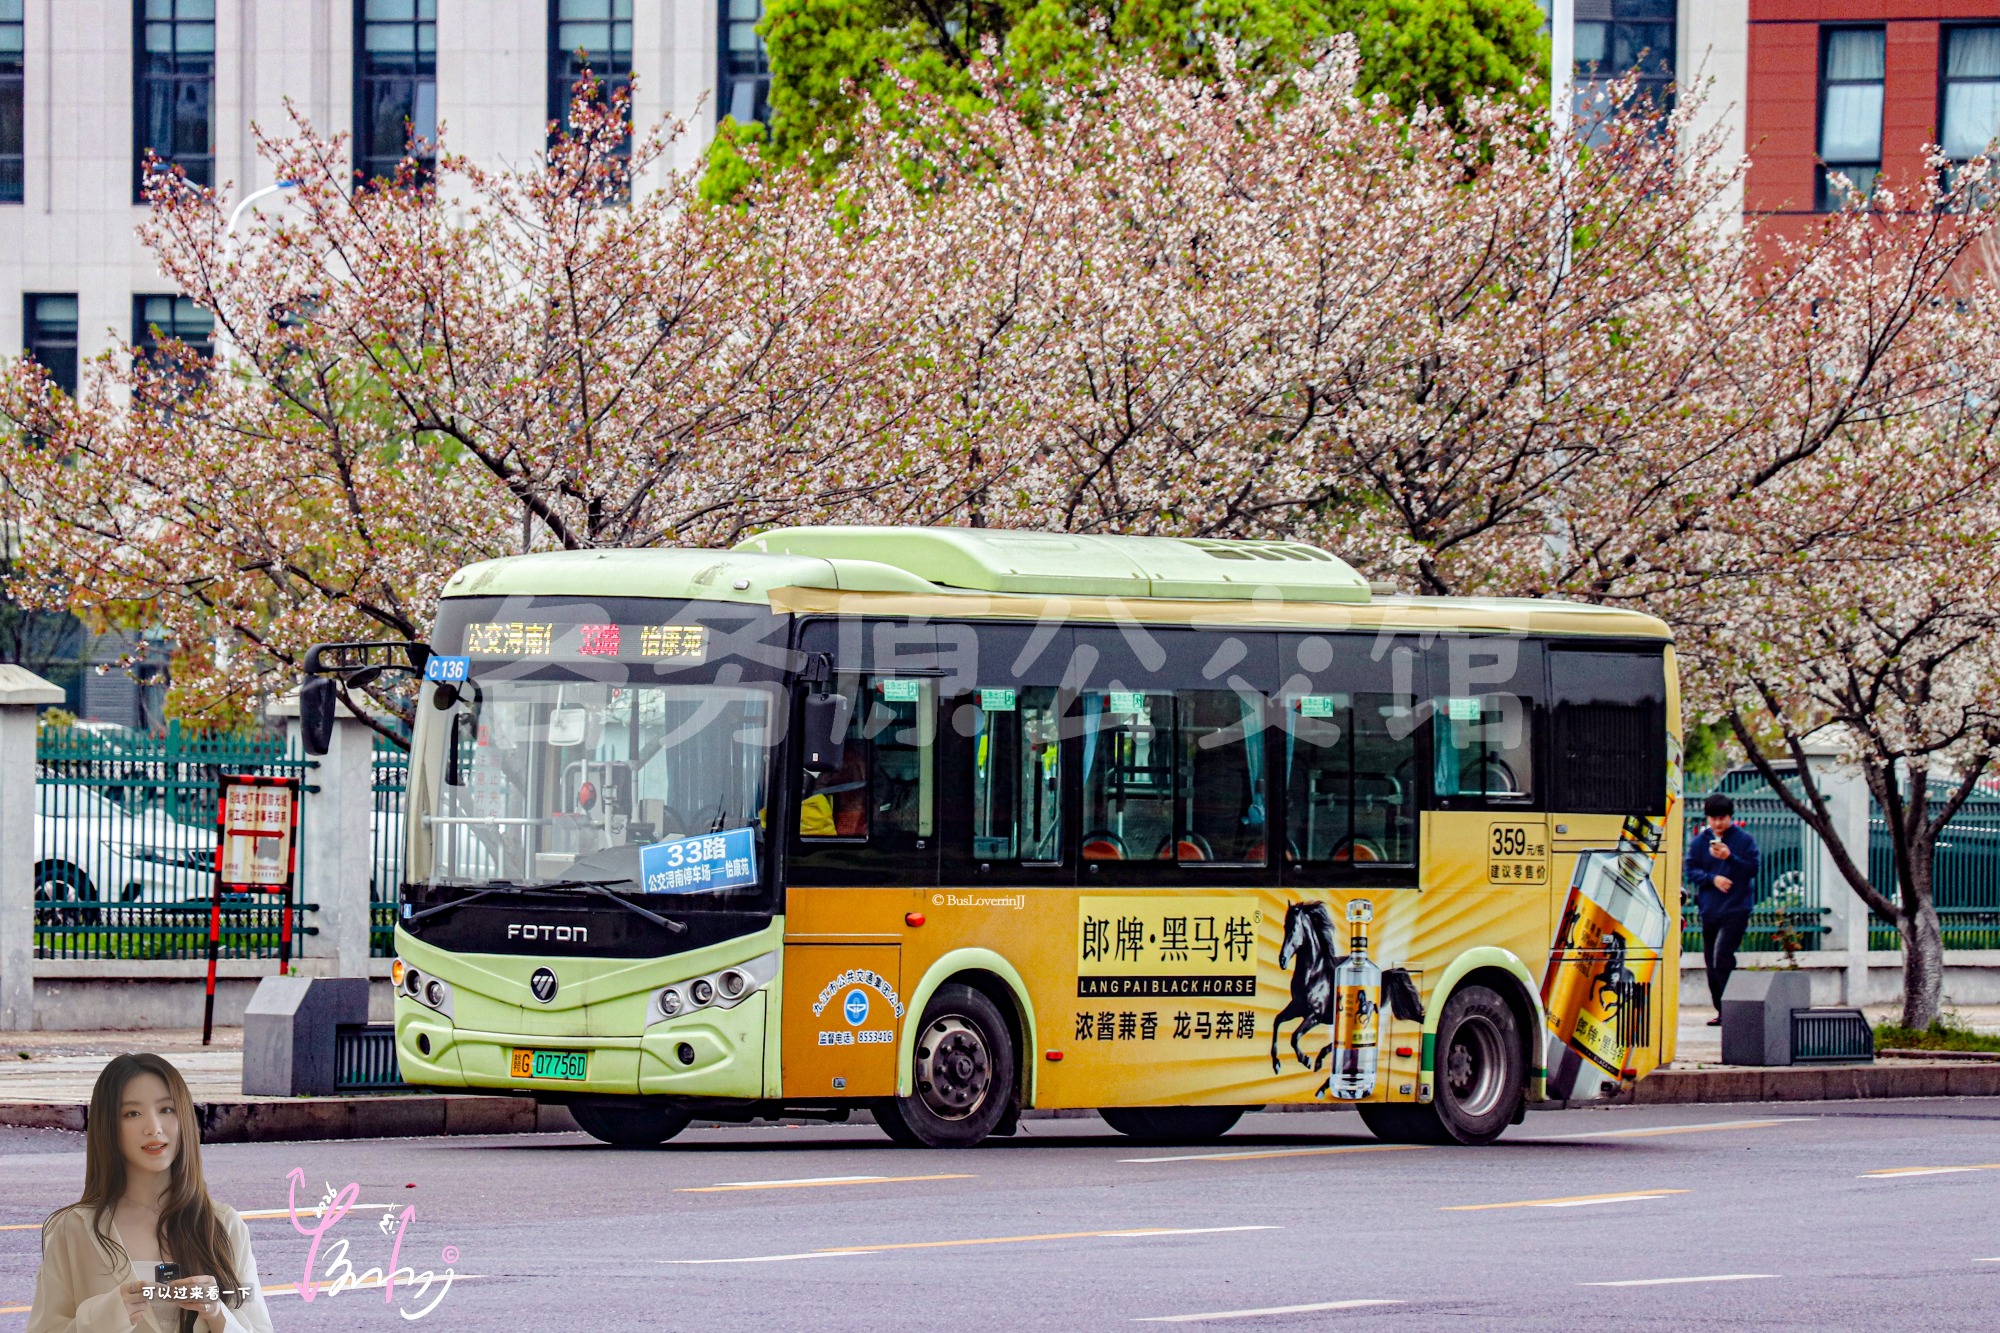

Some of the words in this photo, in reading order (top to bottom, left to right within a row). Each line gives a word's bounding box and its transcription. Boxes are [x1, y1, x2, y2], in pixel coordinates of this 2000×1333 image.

[429, 660, 439, 678] C
[441, 660, 464, 679] 136
[667, 837, 726, 867] 33路
[1492, 828, 1525, 855] 359
[1490, 864, 1546, 879] 建议零售价
[508, 924, 588, 942] FOTON
[1082, 915, 1254, 963] 郎牌·黑马特
[812, 968, 905, 1018] 九江市公共交通集团公司
[1080, 980, 1119, 994] LANG
[1123, 980, 1148, 993] PAI
[1151, 980, 1199, 993] BLACK
[1202, 980, 1254, 993] HORSE
[858, 1030, 893, 1044] 8553416
[1075, 1011, 1158, 1041] 浓酱兼香
[1173, 1010, 1255, 1040] 龙马奔腾
